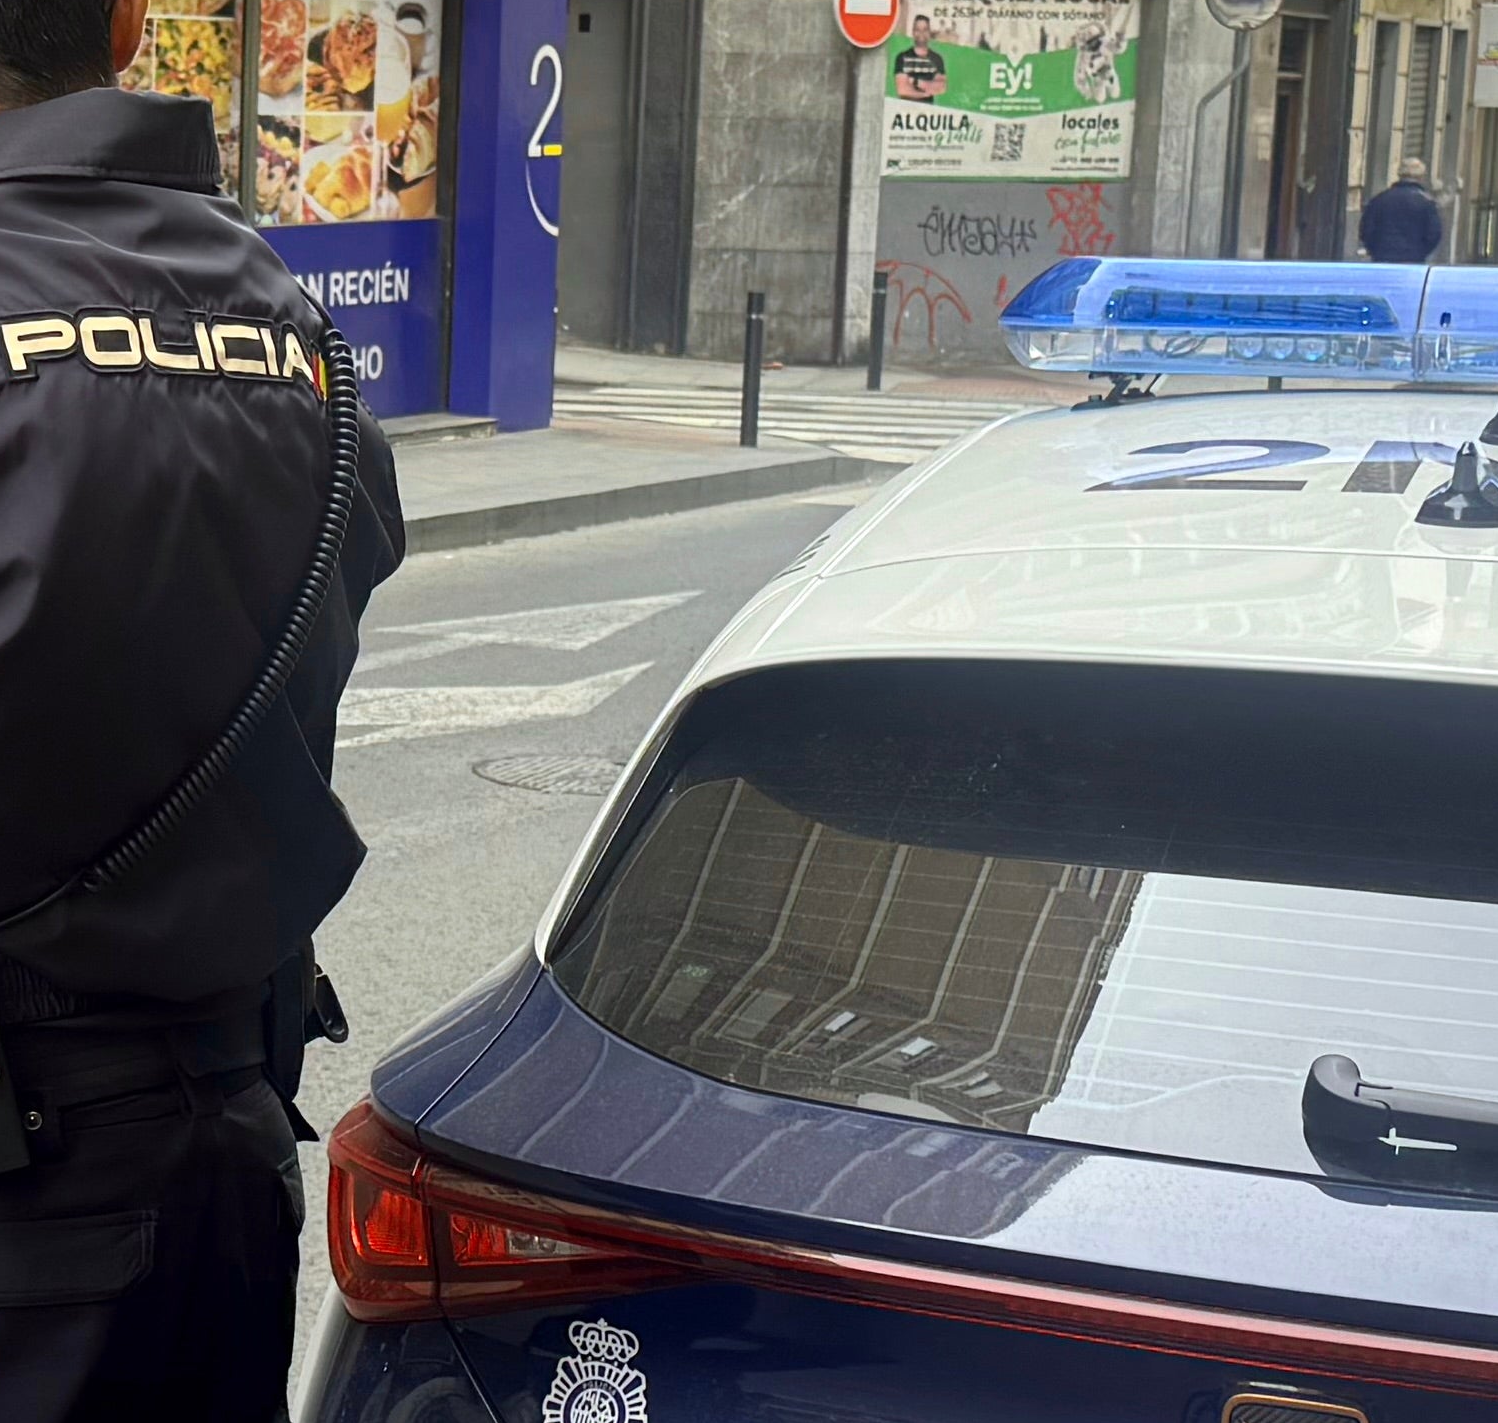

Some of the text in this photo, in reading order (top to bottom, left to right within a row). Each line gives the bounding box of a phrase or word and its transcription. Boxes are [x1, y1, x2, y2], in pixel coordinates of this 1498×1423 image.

[990, 63, 1033, 96] Ey!
[892, 114, 970, 131] ALQUILA
[1062, 113, 1120, 131] locales
[329, 261, 409, 307] RECIÉN
[2, 316, 314, 383] POLICIA
